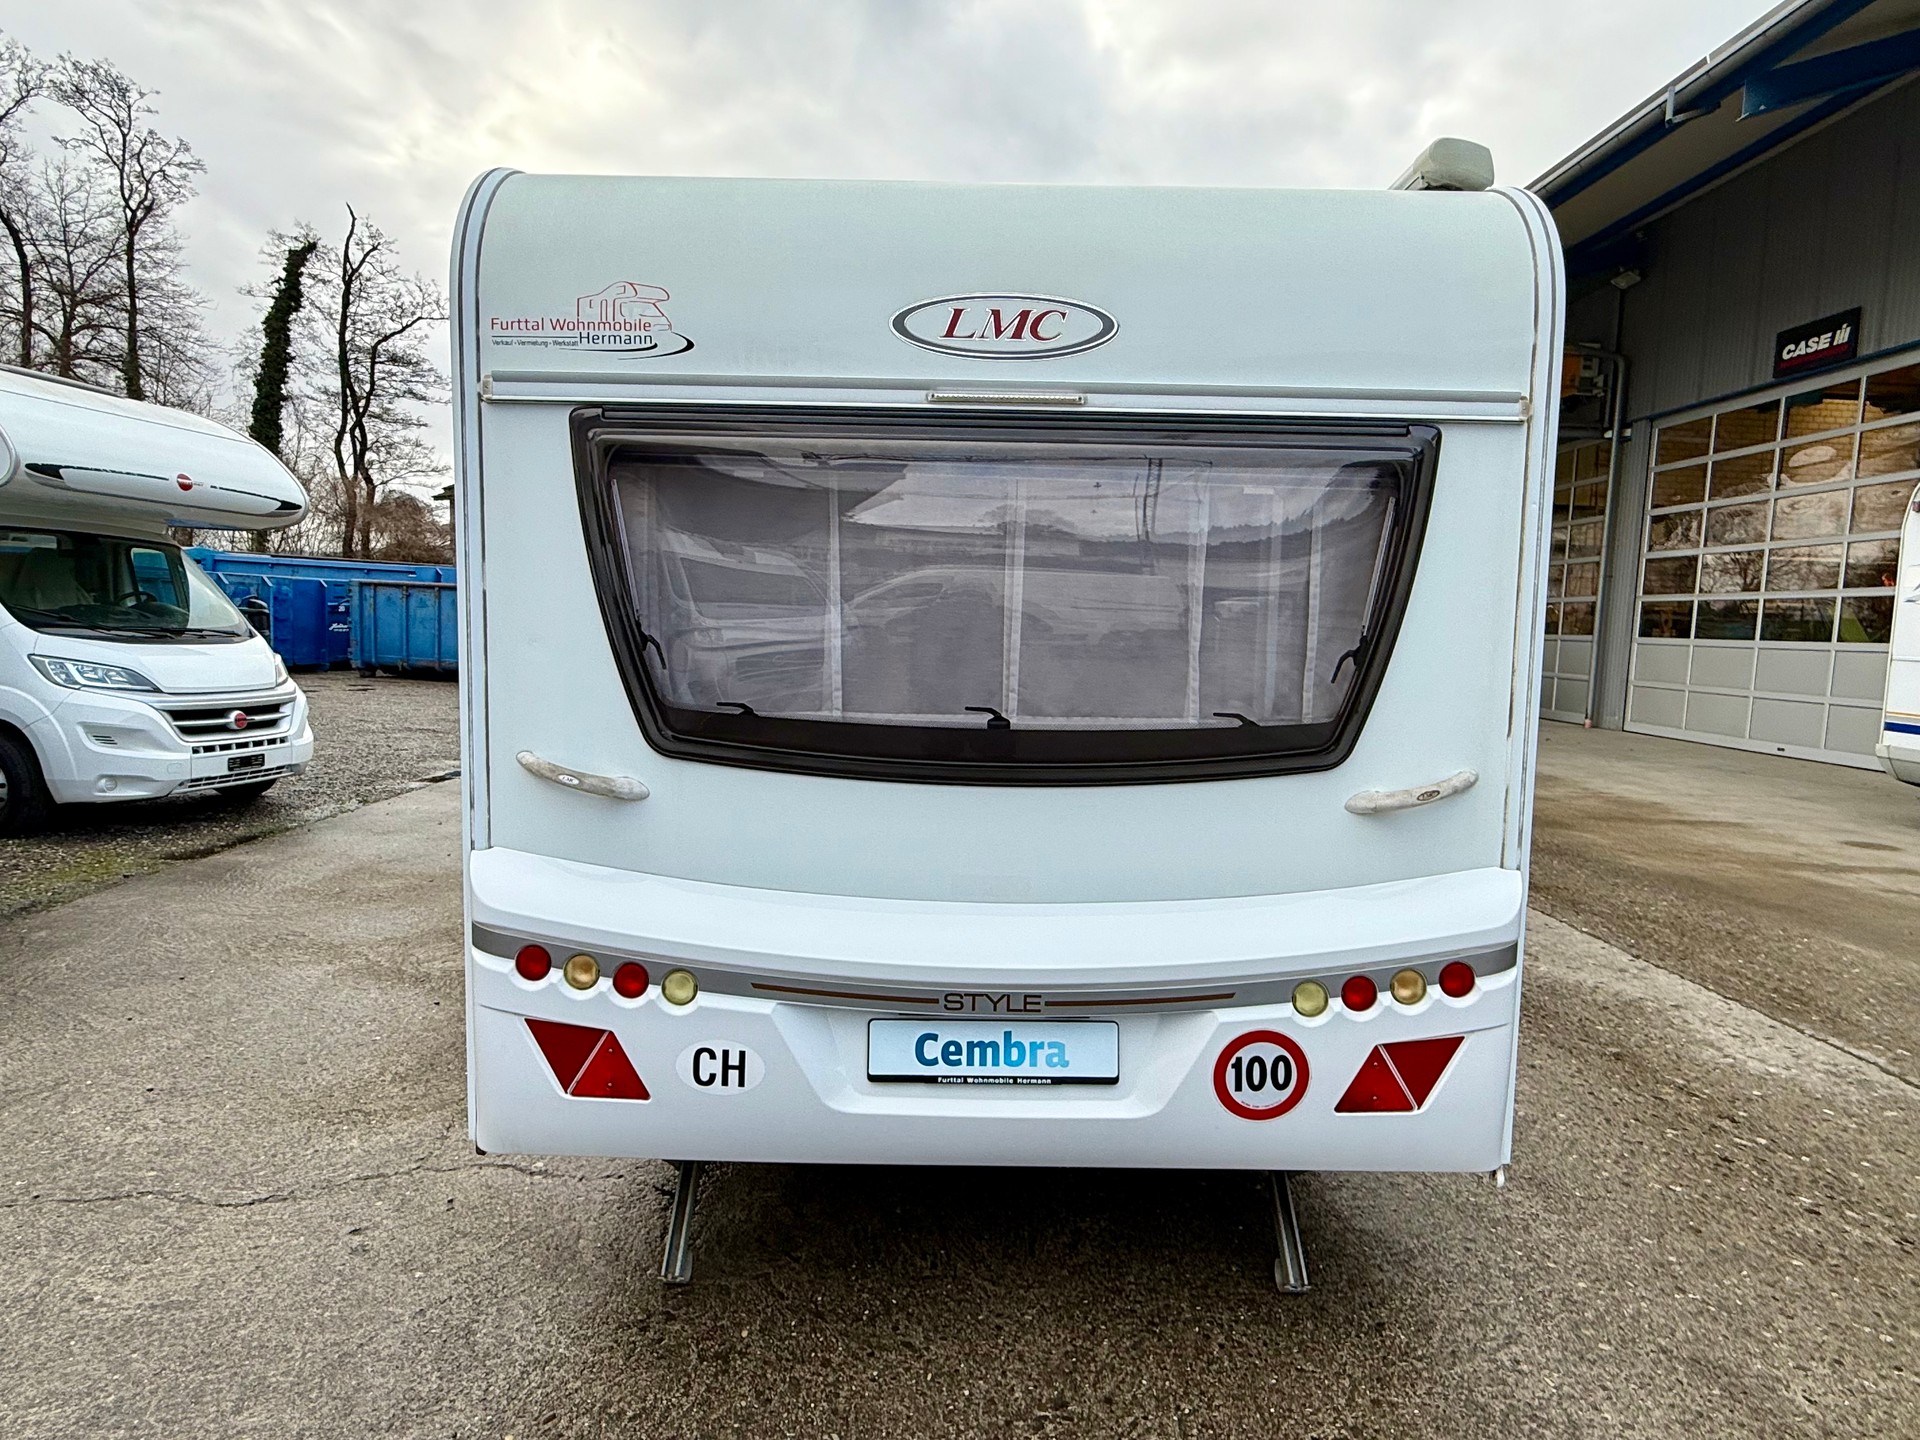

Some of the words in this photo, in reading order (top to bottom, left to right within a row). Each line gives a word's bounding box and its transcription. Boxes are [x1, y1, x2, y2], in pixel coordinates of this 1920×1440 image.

[491, 317, 544, 331] Furttal
[550, 317, 651, 332] Wohnmobile
[579, 332, 653, 345] Hermann
[939, 306, 1068, 342] LMC
[1782, 332, 1833, 360] CASE
[943, 993, 1042, 1013] STYLE
[914, 1030, 1069, 1069] Cembra
[692, 1047, 746, 1088] CH
[1231, 1054, 1292, 1093] 100
